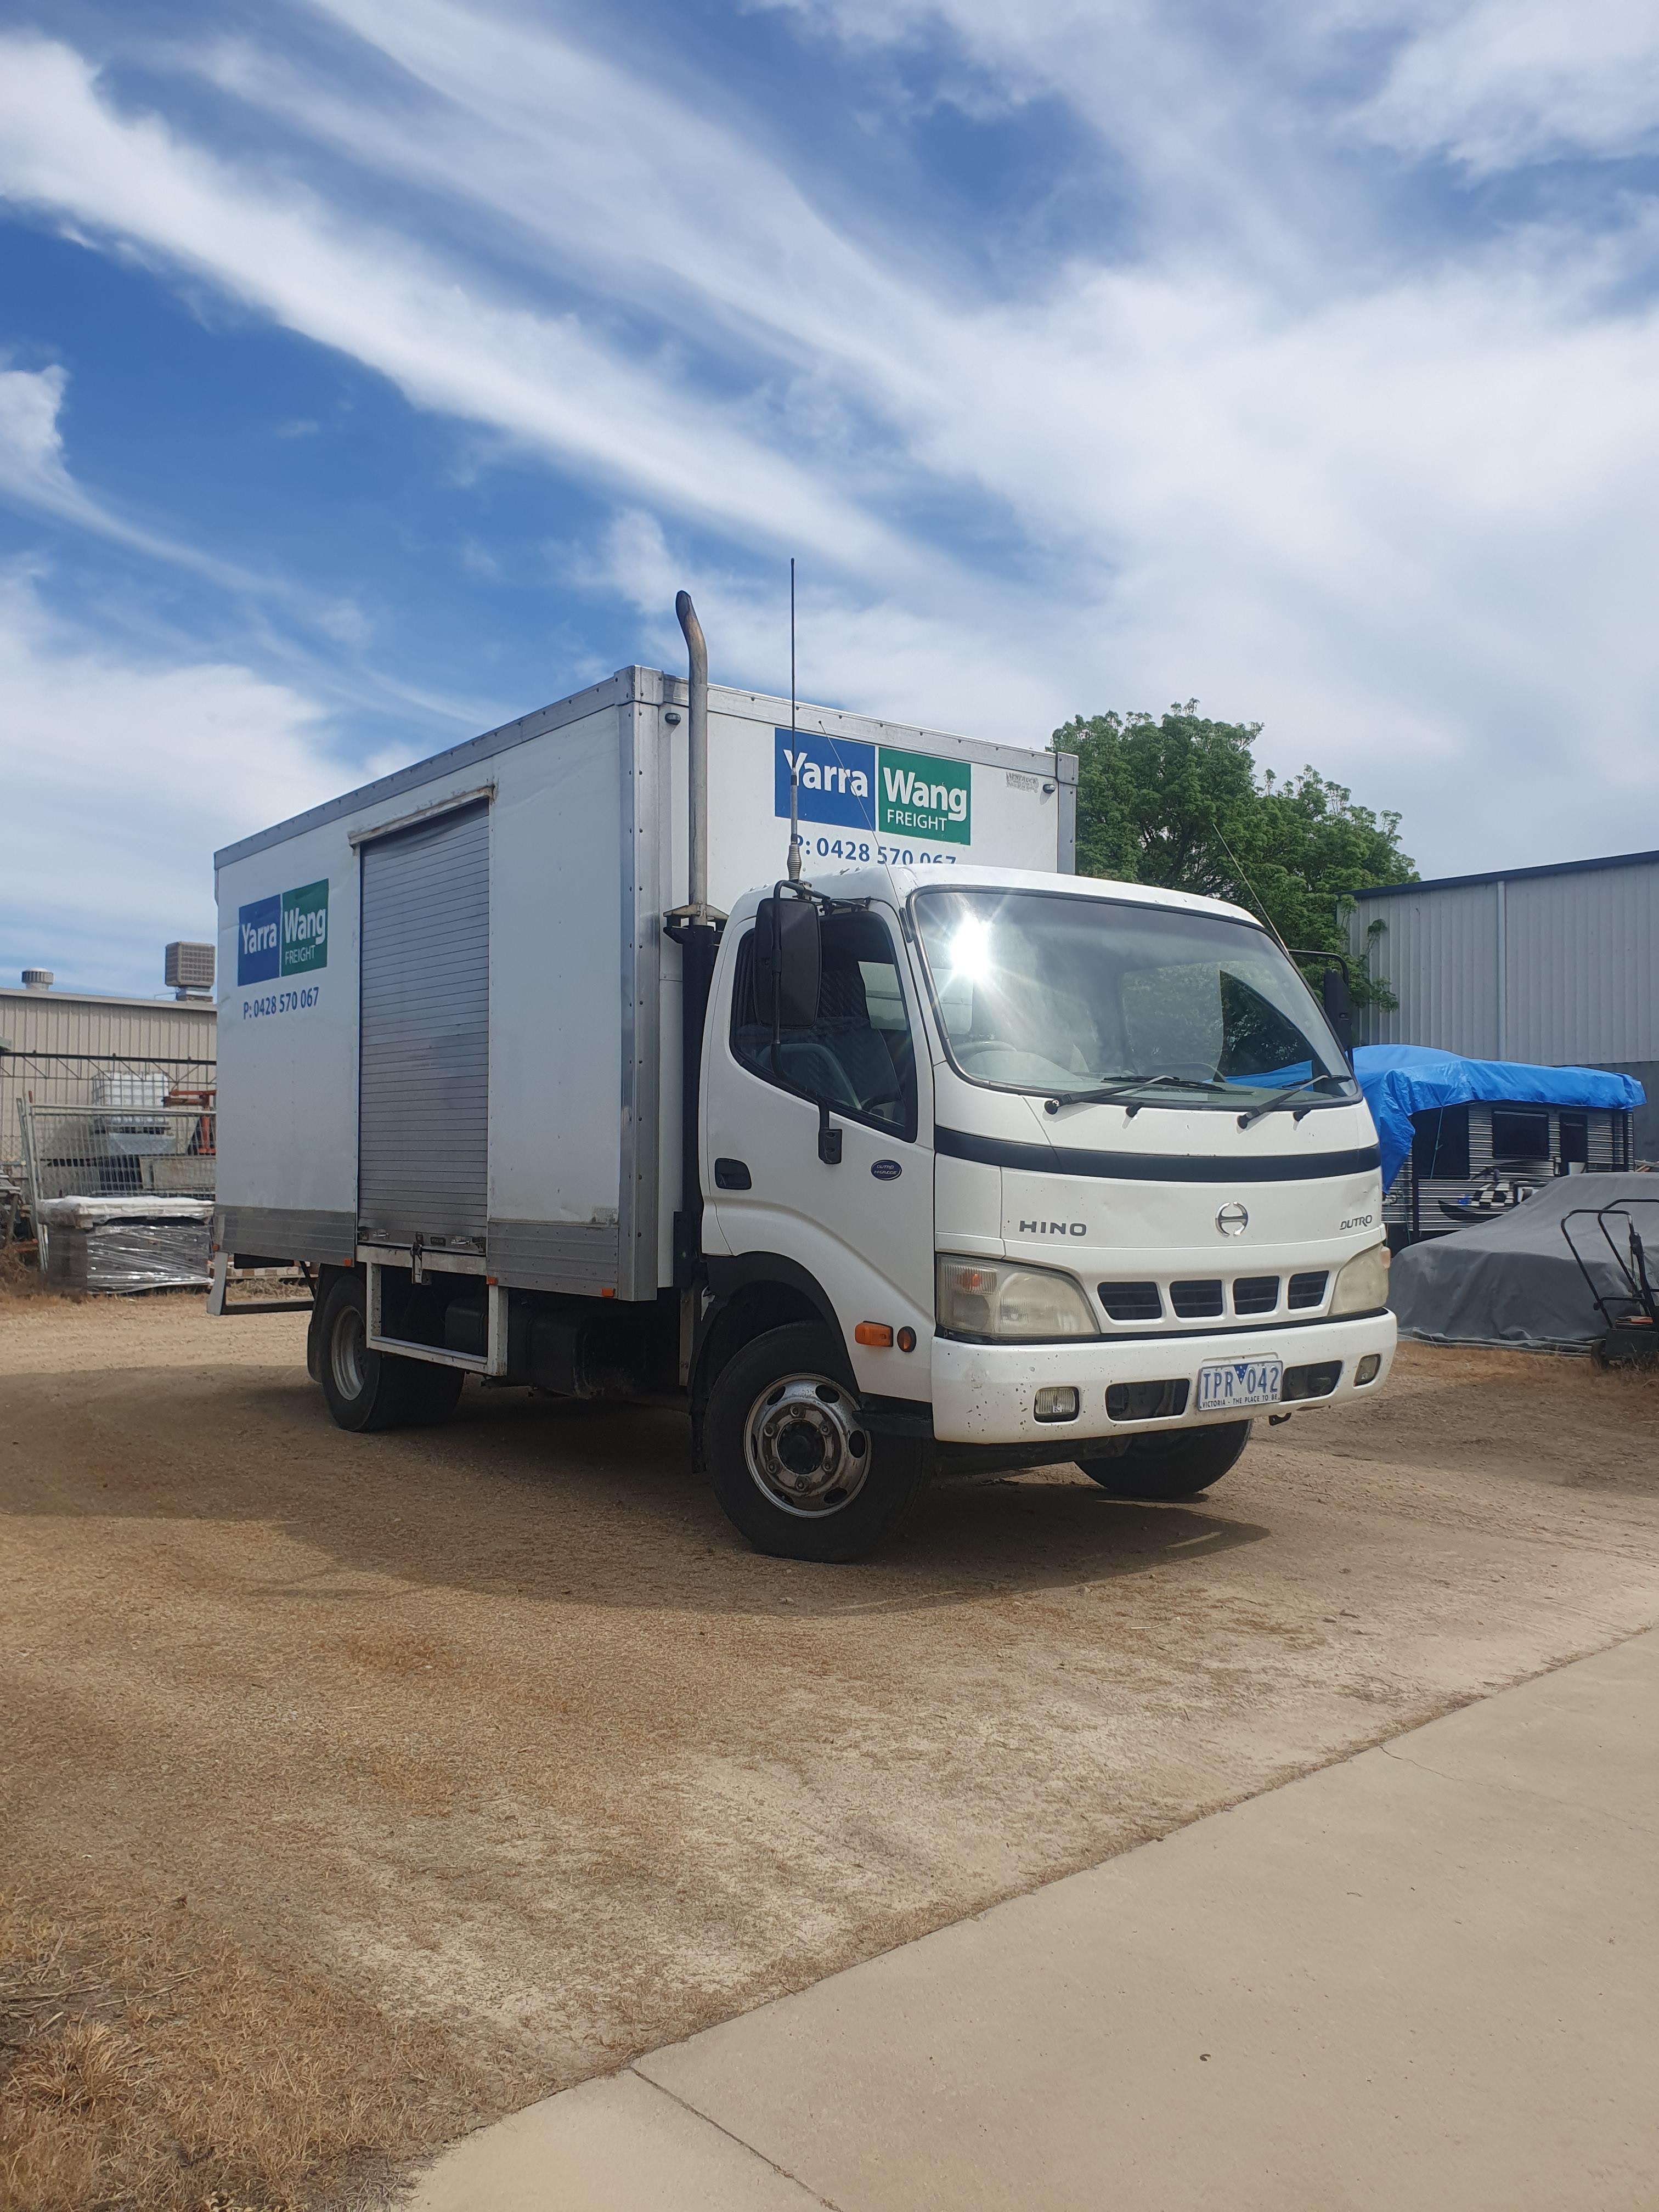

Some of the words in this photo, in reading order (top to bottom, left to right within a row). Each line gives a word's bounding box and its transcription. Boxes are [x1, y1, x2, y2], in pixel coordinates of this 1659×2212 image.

[783, 749, 868, 798] Yarra
[883, 767, 967, 822] Wang
[887, 809, 947, 831] FREIGHT
[816, 838, 870, 862] 0428
[877, 847, 913, 865] 570
[242, 922, 277, 955] Yarra
[284, 907, 326, 945] Wang
[285, 945, 316, 965] FREIGHT
[243, 1001, 252, 1020] P:
[253, 996, 276, 1018] 0428
[279, 991, 298, 1013] 570
[301, 986, 319, 1009] 067
[1019, 1221, 1087, 1236] HINO
[1339, 1215, 1373, 1230] DUTRO
[1203, 1371, 1234, 1400] TPR
[1247, 1366, 1279, 1394] 042
